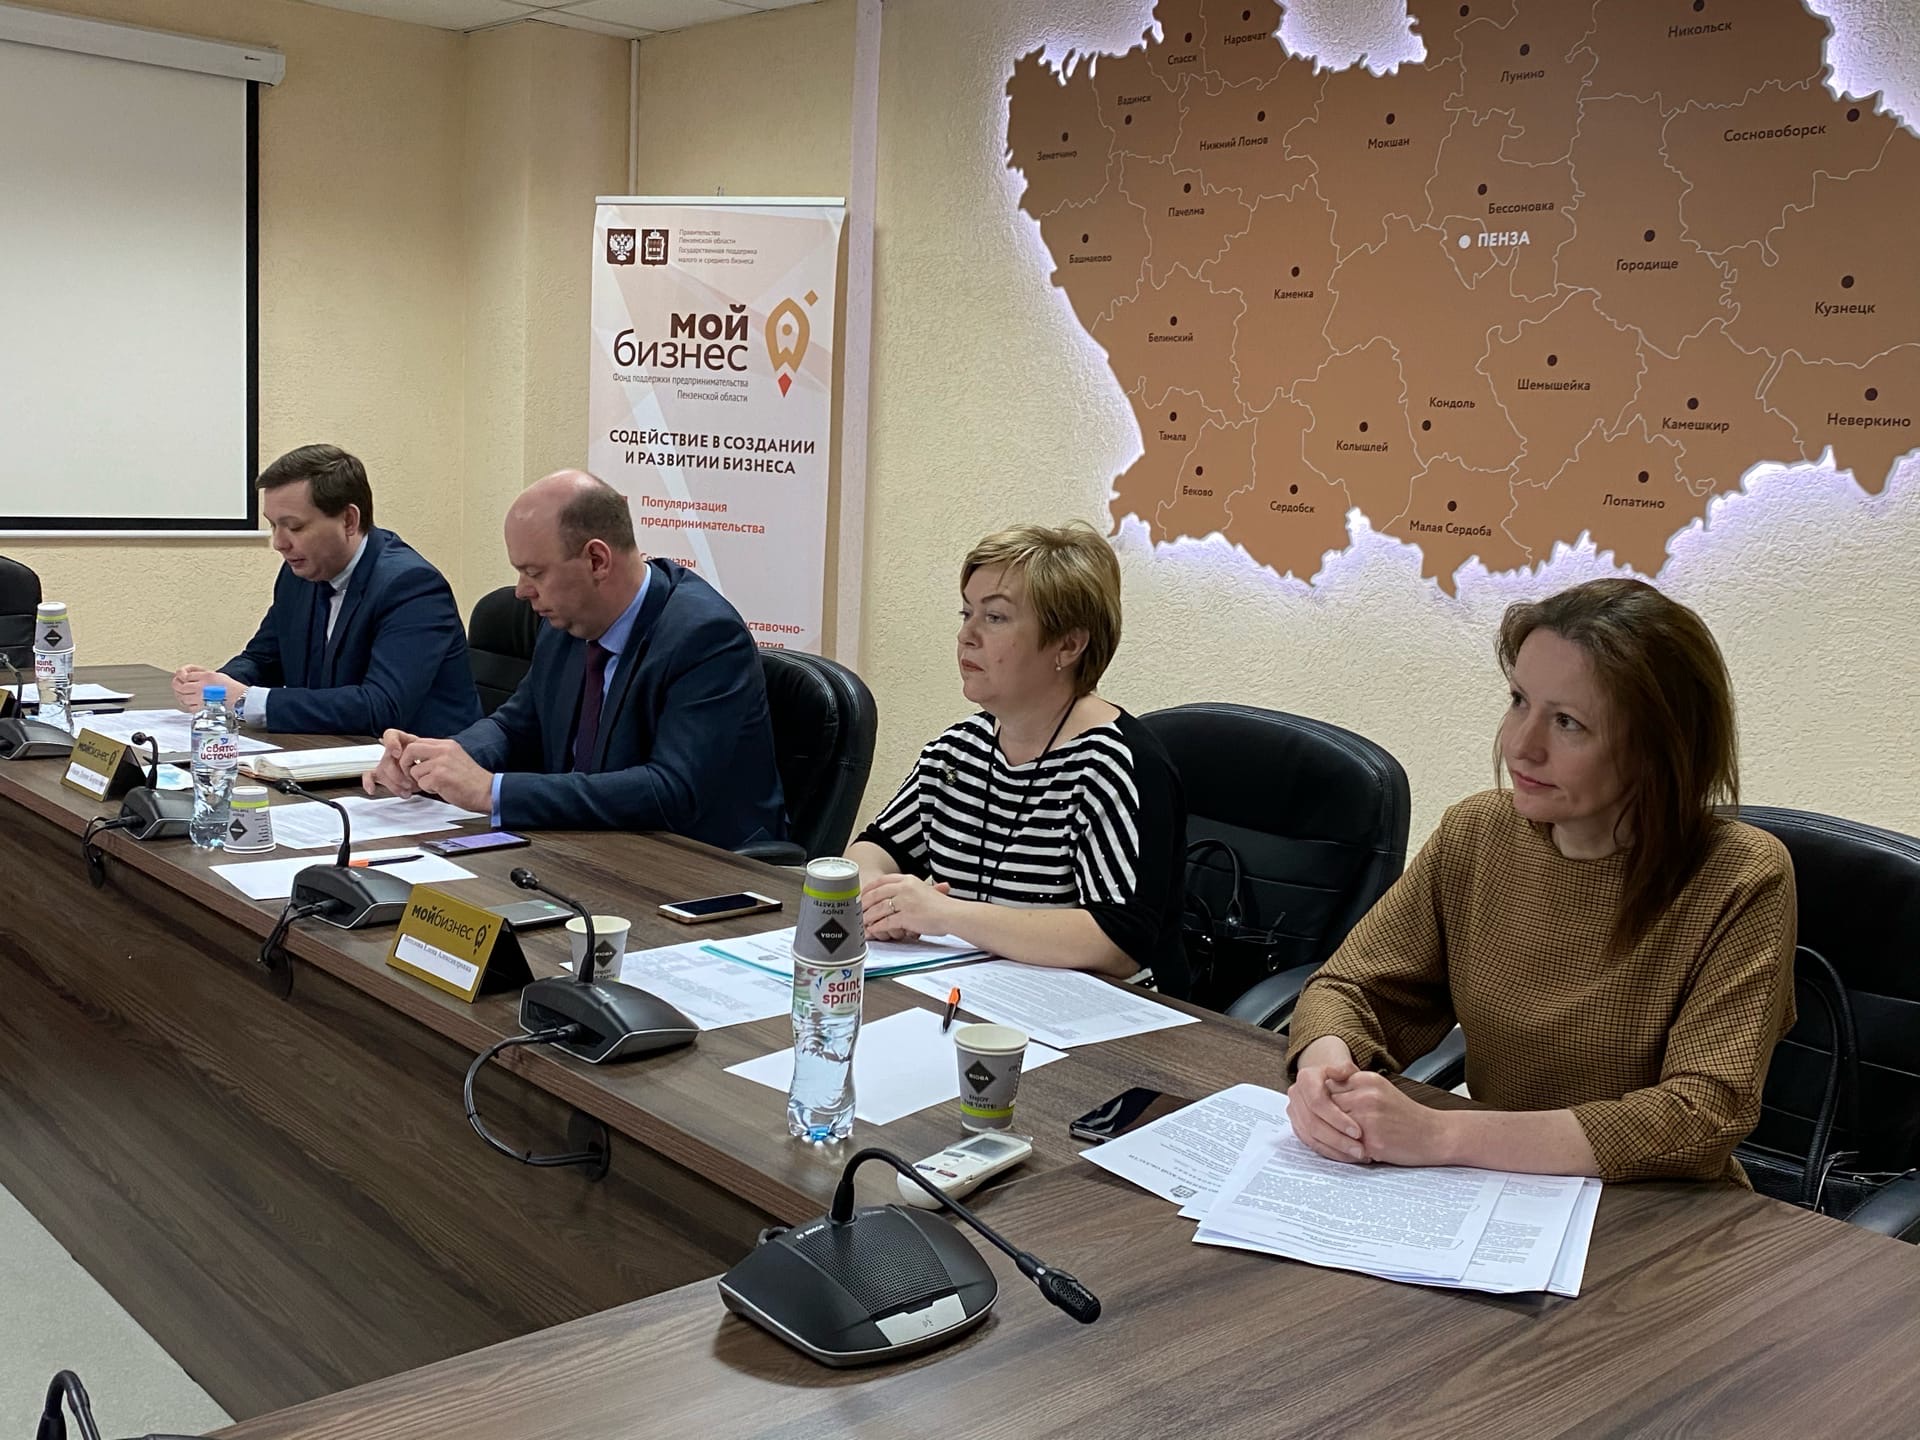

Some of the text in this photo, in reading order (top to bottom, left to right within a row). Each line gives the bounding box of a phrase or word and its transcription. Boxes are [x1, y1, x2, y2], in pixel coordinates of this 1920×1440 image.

[1668, 21, 1732, 38] Никольск
[1223, 32, 1267, 44] Наровчат
[1167, 54, 1197, 65] Спасск
[1500, 69, 1545, 83] Лунино
[1724, 123, 1826, 142] Сосновоборск
[1200, 136, 1268, 151] Нижний Ломов
[1367, 137, 1410, 149] Мокшан
[1168, 207, 1205, 217] Пачелма
[1488, 201, 1554, 214] Бессоновка
[1477, 230, 1530, 247] ПЕНЗА
[1616, 259, 1679, 272] Городище
[1274, 288, 1314, 299] Каменка
[1815, 301, 1876, 315] Кузнецк
[670, 303, 748, 341] мой
[1148, 332, 1194, 343] Белинский
[613, 328, 748, 371] бизнес
[612, 372, 749, 388] Фонд поддержки предпринимательства
[1517, 378, 1591, 392] Шемышейка
[677, 389, 748, 403] Пензенской области
[1429, 397, 1476, 409] Кондоль
[1662, 417, 1730, 434] Камешкир
[1827, 413, 1911, 428] Неверкино
[609, 428, 815, 454] СОДЕЙСТВИЕ В СОЗДАНИИ
[1158, 430, 1187, 441] Тамала
[1336, 440, 1388, 452] Колышлей
[625, 452, 796, 474] И РАЗВИТИИ БИЗНЕСА
[1182, 485, 1213, 497] Беково
[641, 496, 728, 514] Популяризация
[1270, 501, 1315, 514] Сердобск
[1602, 494, 1665, 510] Лопатино
[640, 517, 765, 534] предпринимательства
[1409, 520, 1492, 537] Малая Сердоба
